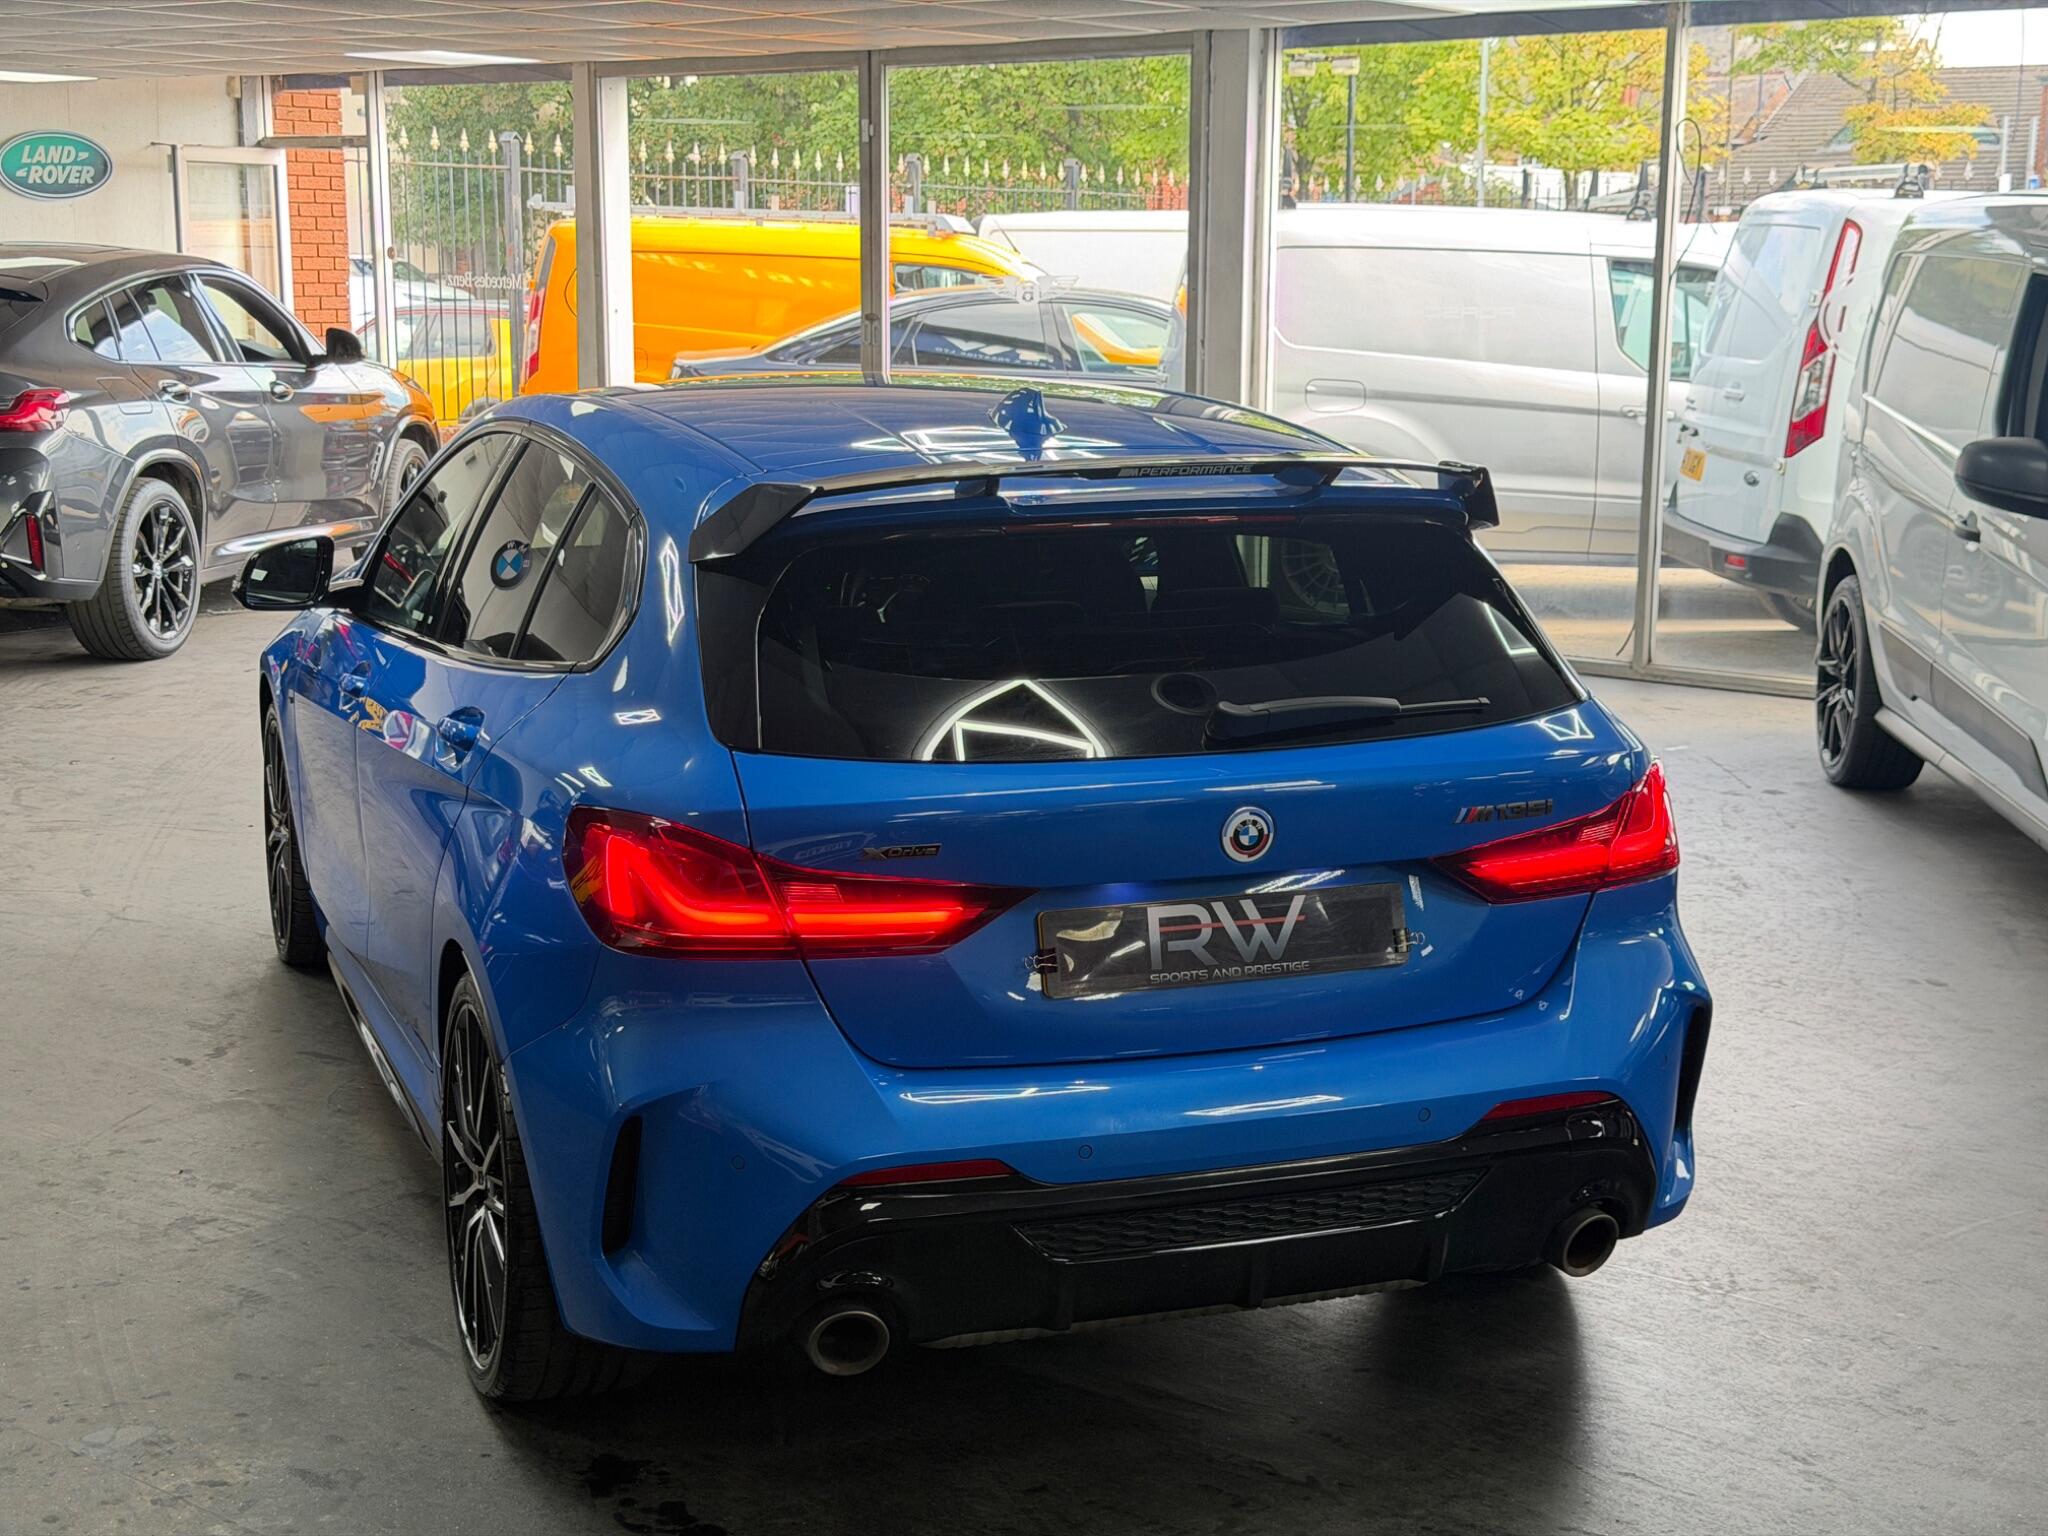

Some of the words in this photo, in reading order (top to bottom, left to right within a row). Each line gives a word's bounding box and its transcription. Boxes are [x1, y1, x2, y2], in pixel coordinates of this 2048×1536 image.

[21, 145, 77, 164] LAND
[27, 165, 96, 184] ROVER
[1140, 464, 1254, 477] PERFORMANCE
[1147, 894, 1306, 970] RW
[1150, 969, 1208, 984] SPORTS
[1212, 966, 1242, 979] AND
[1244, 960, 1312, 976] PRESTIGE
